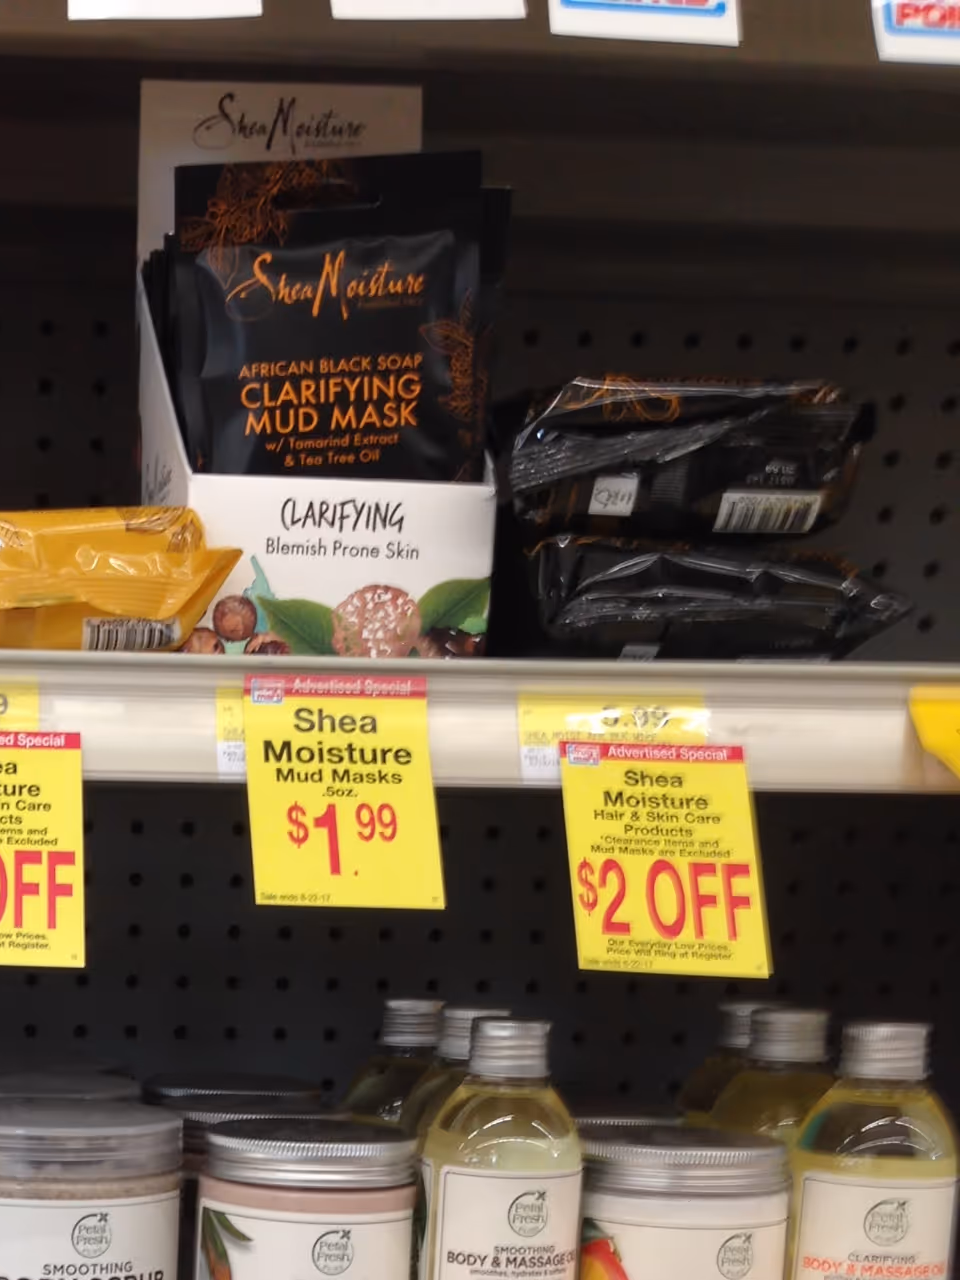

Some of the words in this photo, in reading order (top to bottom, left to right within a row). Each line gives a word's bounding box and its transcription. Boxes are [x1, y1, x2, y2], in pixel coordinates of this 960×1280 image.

[239, 359, 314, 381] AFRICAN
[319, 356, 371, 376] BLACK
[377, 352, 424, 372] SOAP
[240, 372, 423, 410] CLARIFYING
[244, 407, 319, 437] MUD
[330, 400, 418, 430] MASK
[280, 497, 405, 534] CLARIFYING
[265, 537, 327, 557] Blemish
[333, 540, 380, 559] Prone
[385, 540, 420, 560] Skin
[293, 708, 378, 734] Shea
[17, 733, 65, 749] Special
[263, 740, 412, 765] Moisture
[607, 745, 676, 760] Advertised
[680, 747, 728, 763] Special
[624, 770, 683, 788] Shea
[15, 800, 52, 812] Care
[603, 791, 708, 810] Moisture
[6, 836, 58, 846] Excluded
[577, 857, 631, 936] $2
[645, 858, 751, 941] OFF
[42, 1261, 133, 1276] SMOOTHING
[447, 1251, 488, 1267] BODY
[491, 1256, 501, 1268] &
[505, 1253, 566, 1268] MASSAGE
